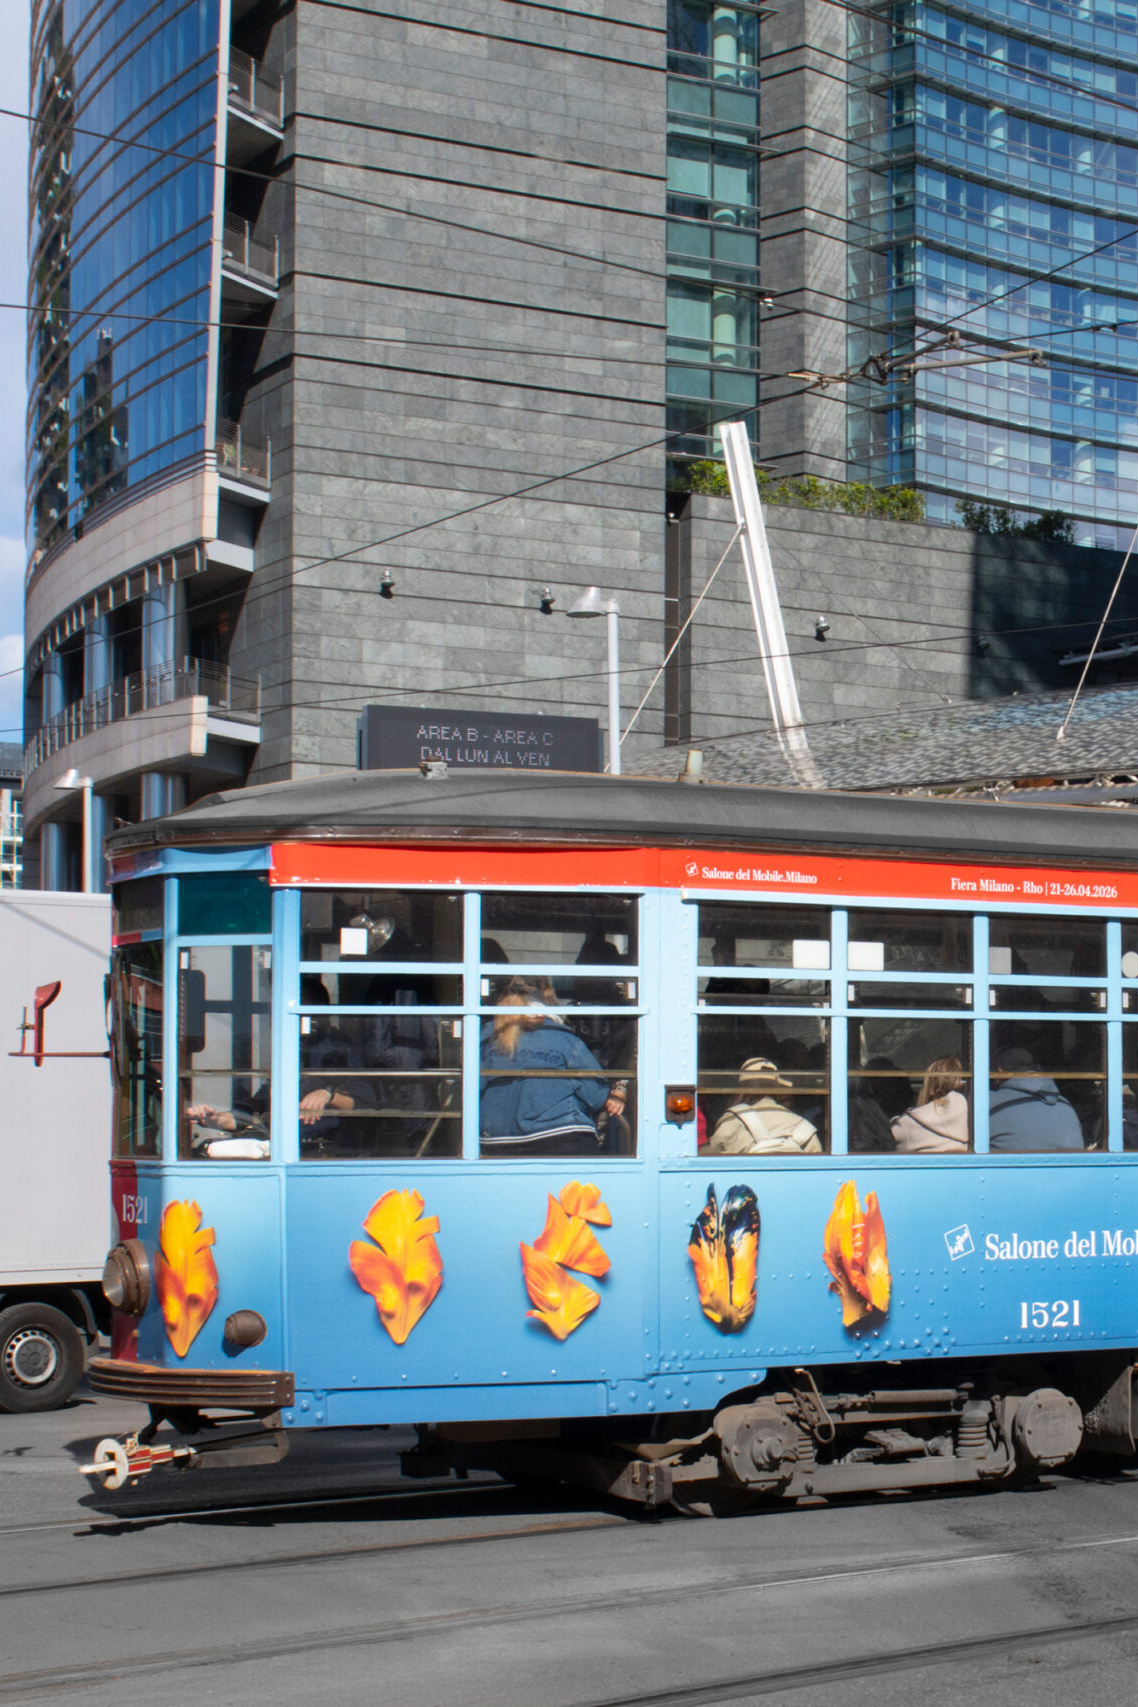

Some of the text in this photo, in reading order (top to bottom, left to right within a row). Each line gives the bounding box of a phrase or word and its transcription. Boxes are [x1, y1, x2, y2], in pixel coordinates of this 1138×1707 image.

[416, 725, 462, 740] AREA
[467, 728, 479, 741] B
[493, 730, 538, 745] AREA
[542, 732, 553, 746] C
[420, 746, 550, 767] DAL LUN AL VEN
[702, 867, 817, 884] Salone del Mobile.Milano
[951, 877, 977, 891] Fiera
[979, 879, 1014, 893] Milano
[1023, 881, 1043, 894] Rho
[1050, 882, 1118, 898] 21-26.04.2026
[122, 1194, 148, 1225] 1521
[985, 1233, 1059, 1260] Salone
[1064, 1231, 1097, 1258] del
[1020, 1299, 1081, 1329] 1521
